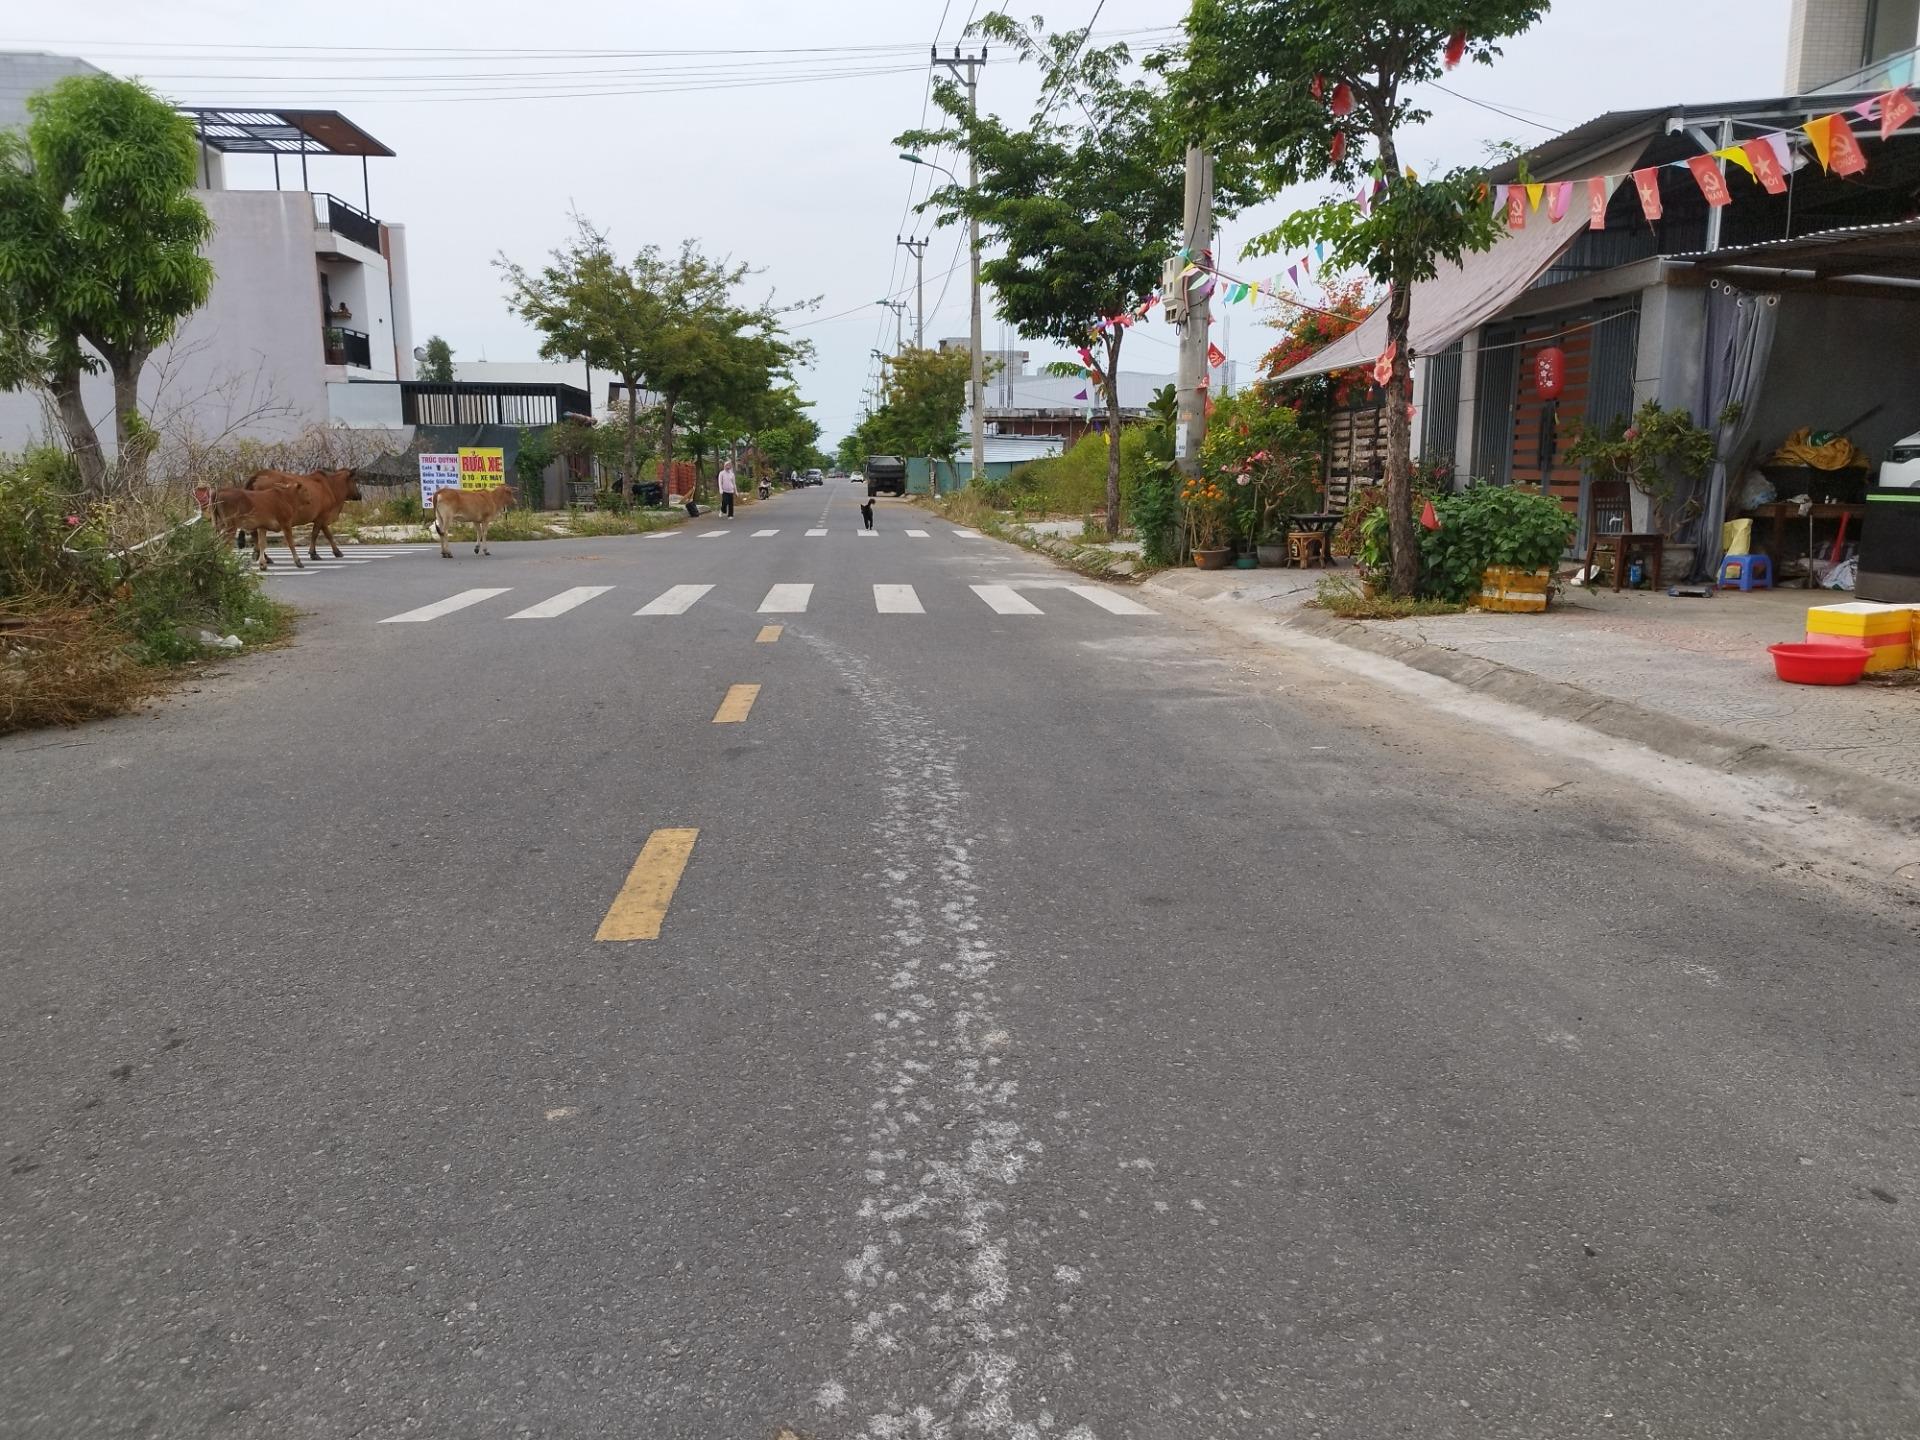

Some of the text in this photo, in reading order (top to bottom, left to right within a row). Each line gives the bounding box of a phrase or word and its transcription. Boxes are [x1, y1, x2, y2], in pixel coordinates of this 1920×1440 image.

[421, 456, 437, 464] TRÚC
[462, 450, 502, 472] RỬA XE
